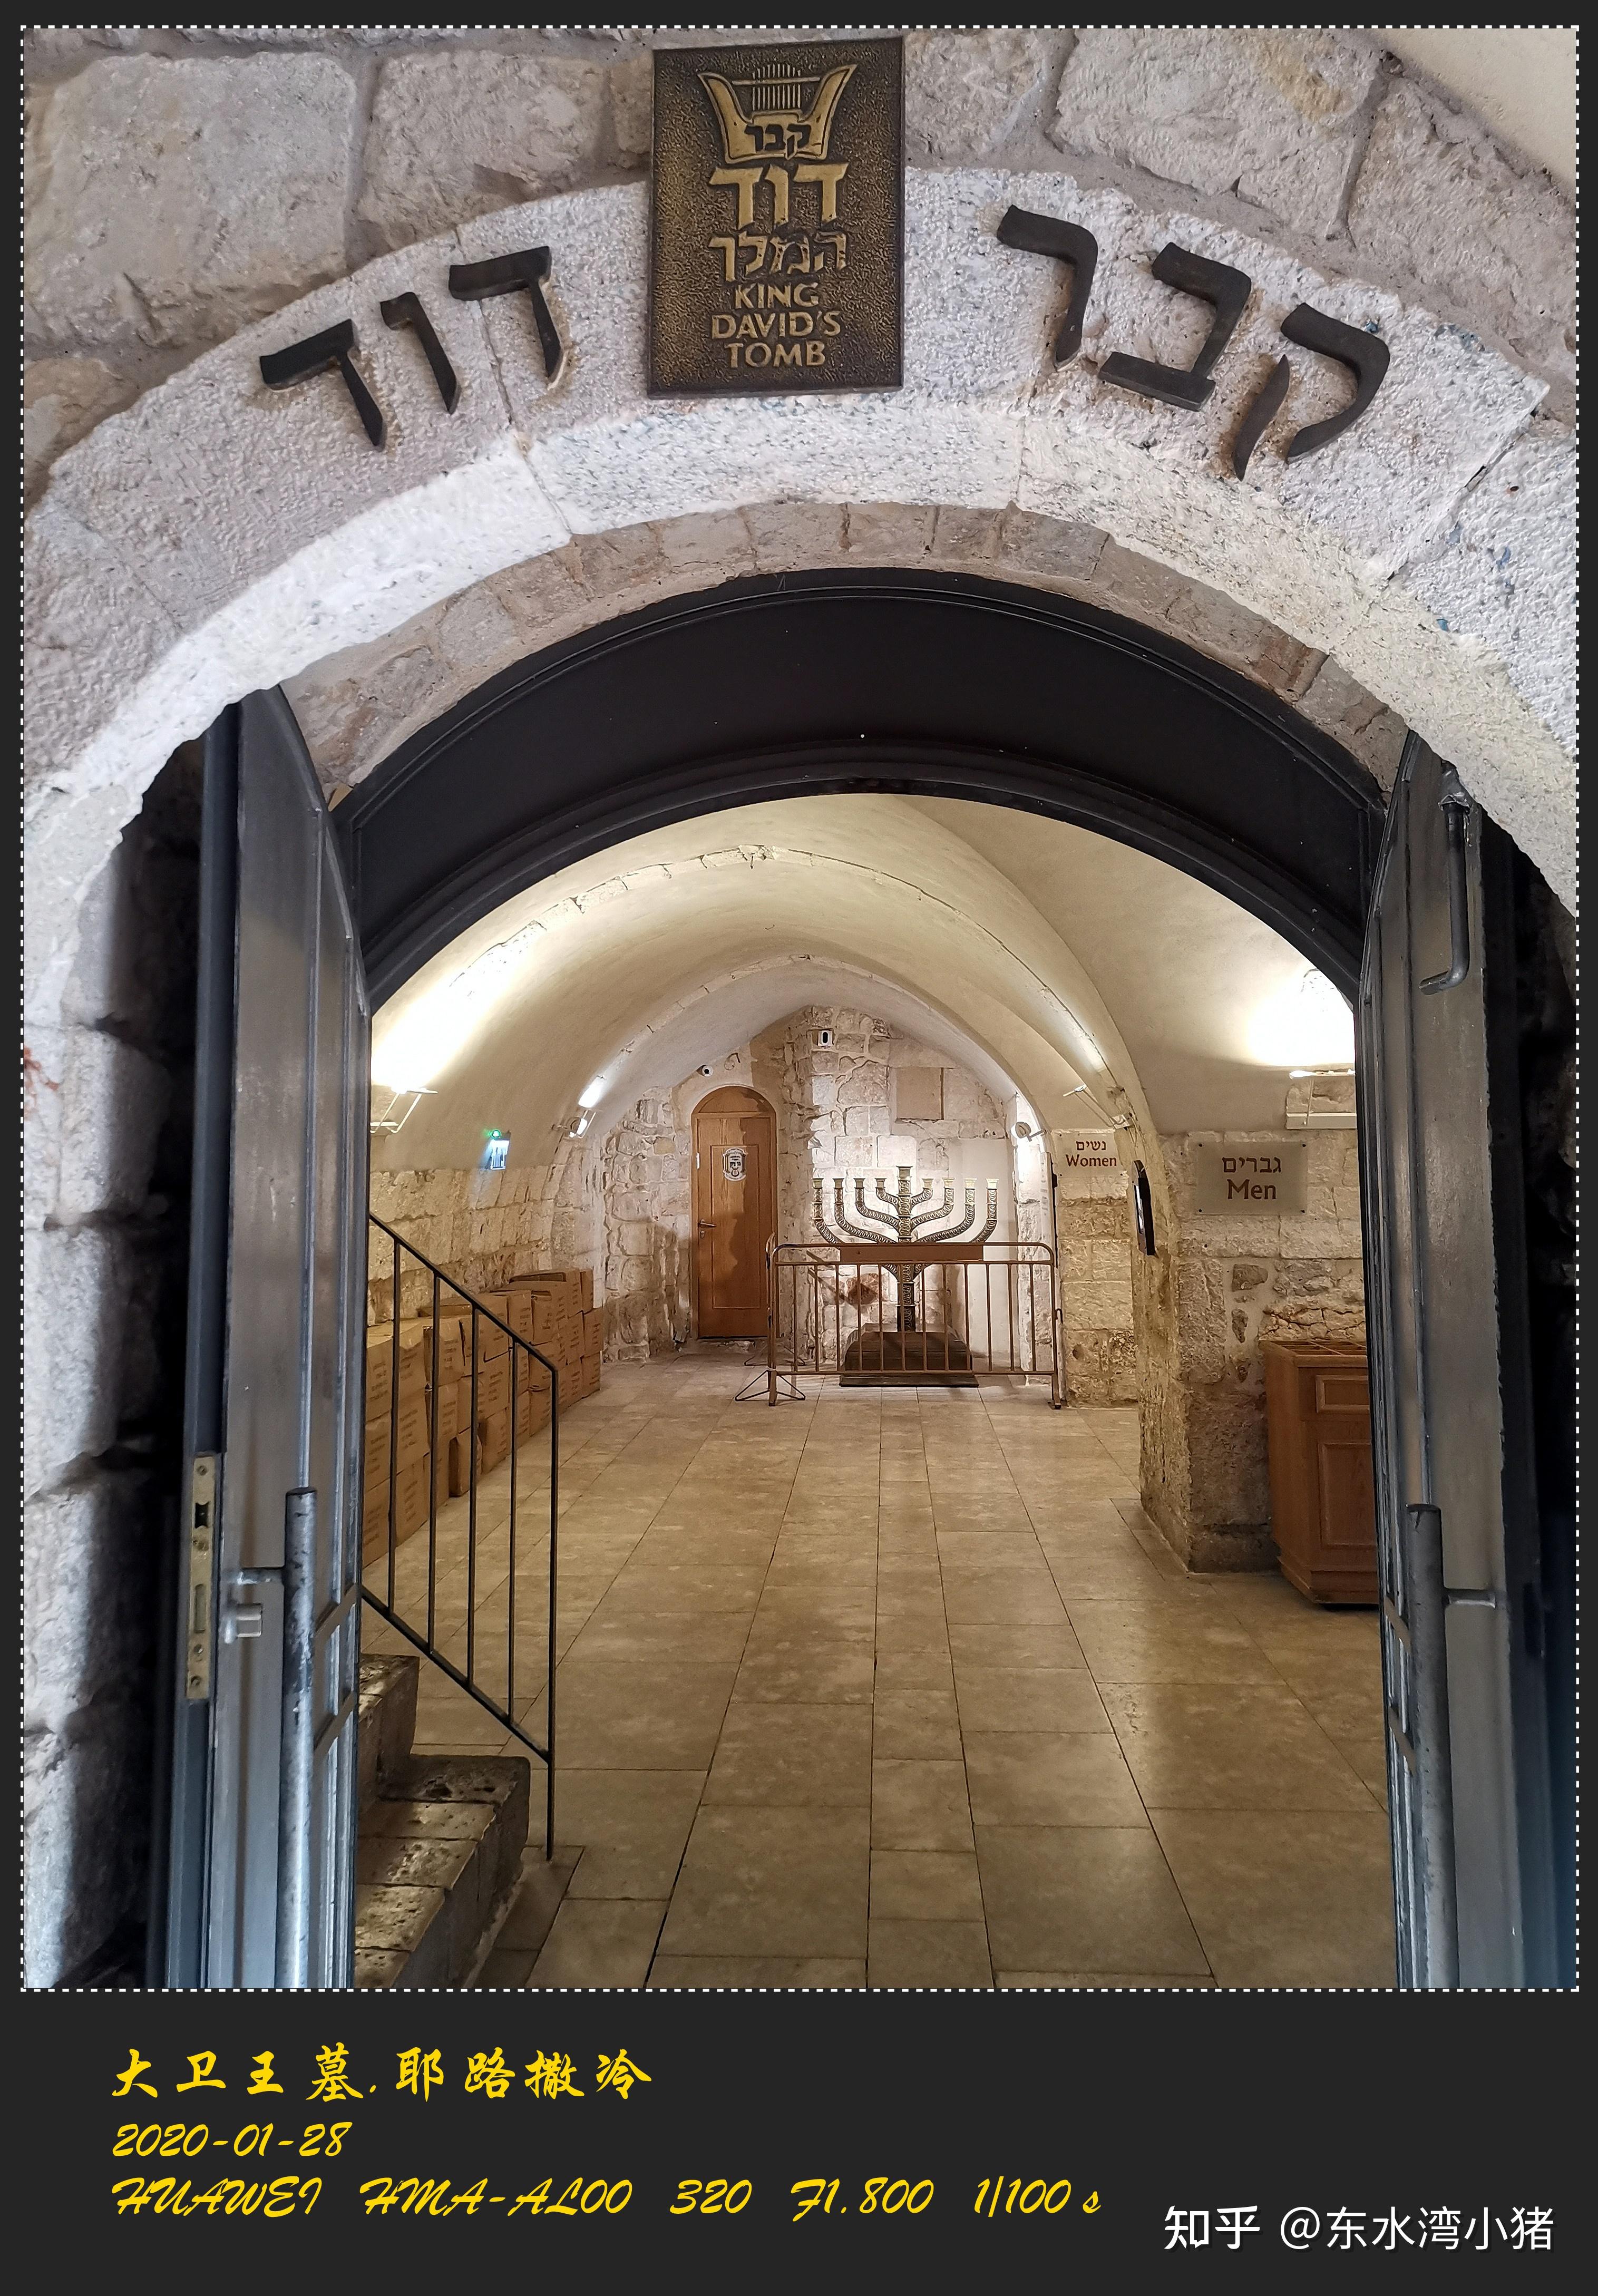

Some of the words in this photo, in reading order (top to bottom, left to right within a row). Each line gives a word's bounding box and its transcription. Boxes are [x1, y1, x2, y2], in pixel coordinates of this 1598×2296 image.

[745, 124, 812, 160] קבר
[709, 163, 849, 230] דוד
[709, 230, 847, 281] המלך
[735, 282, 820, 309] KING
[712, 310, 842, 339] DAVID'S
[259, 246, 564, 452] דוד
[724, 340, 827, 368] TOMB
[997, 204, 1390, 482] קבר
[1076, 1140, 1107, 1151] נשים
[1065, 1154, 1117, 1168] Women
[1221, 1156, 1282, 1173] גברים
[1226, 1179, 1278, 1200] Men
